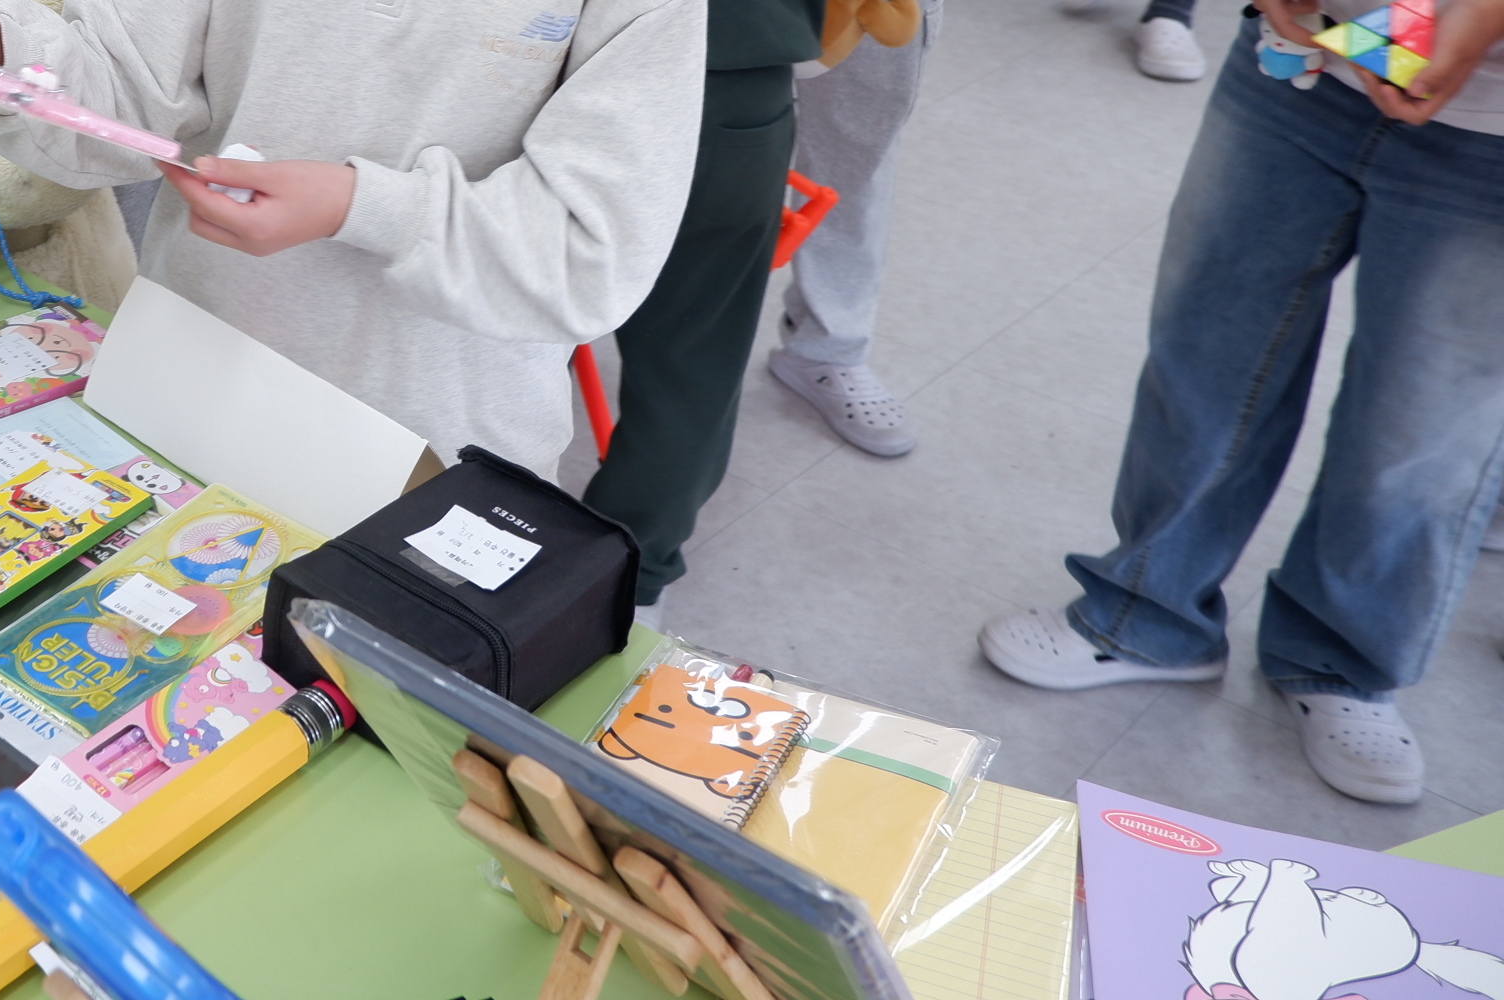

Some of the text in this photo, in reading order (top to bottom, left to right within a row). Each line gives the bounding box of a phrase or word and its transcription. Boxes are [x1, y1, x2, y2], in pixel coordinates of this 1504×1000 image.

[492, 506, 536, 532] PIECES
[445, 551, 472, 566] <가격표>
[482, 540, 515, 558] 물건 주인
[155, 588, 167, 596] 100
[150, 621, 164, 631] 물품
[39, 631, 129, 695] RULER
[8, 639, 117, 713] DESIGN
[1119, 816, 1201, 849] Premium
